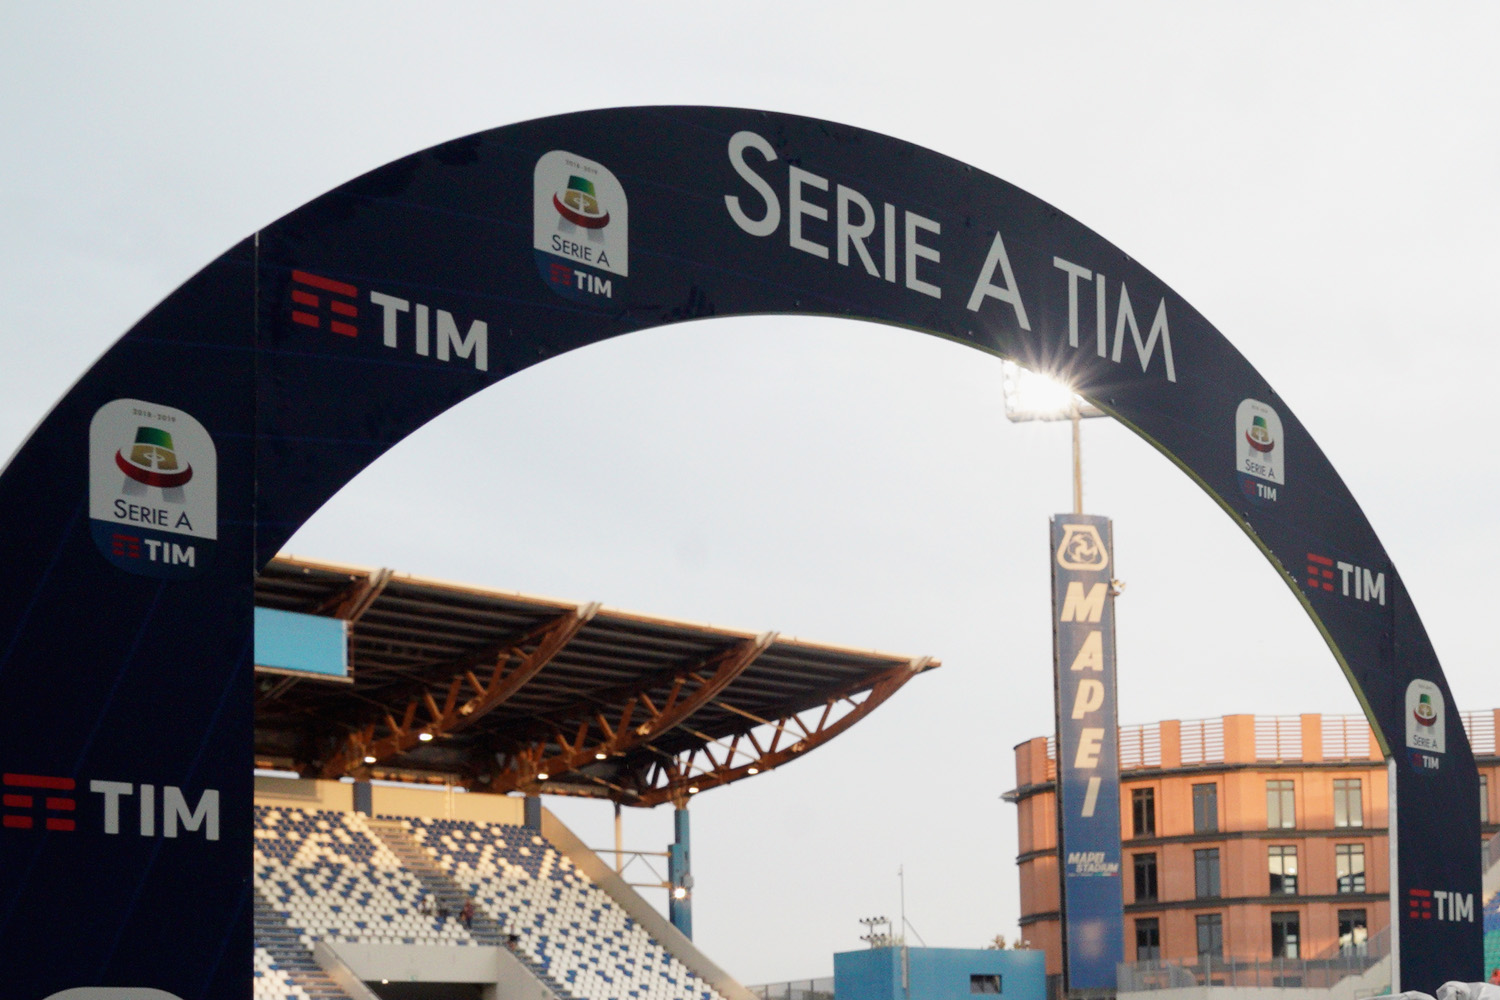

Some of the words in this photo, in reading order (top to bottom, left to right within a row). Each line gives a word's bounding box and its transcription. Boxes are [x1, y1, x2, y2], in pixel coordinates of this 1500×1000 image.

[551, 234, 592, 262] SERIE
[596, 250, 610, 267] A
[724, 130, 942, 299] SERIE
[966, 230, 1032, 332] A
[1053, 255, 1177, 383] TIM
[573, 270, 612, 298] TIM
[370, 290, 488, 372] TIM
[1245, 459, 1266, 476] SERIE
[1267, 467, 1275, 480] A
[1257, 484, 1276, 501] TIM
[113, 499, 168, 526] SERIE
[175, 511, 193, 531] A
[144, 538, 195, 568] TIM
[1337, 561, 1386, 606] TIM
[1060, 581, 1108, 817] MAPEI
[1413, 734, 1430, 748] SERIE
[1430, 736, 1438, 750] A
[1423, 755, 1439, 769] TIM
[90, 779, 220, 841] TIM
[1068, 852, 1105, 864] MAPEI
[1433, 890, 1475, 923] TIM
